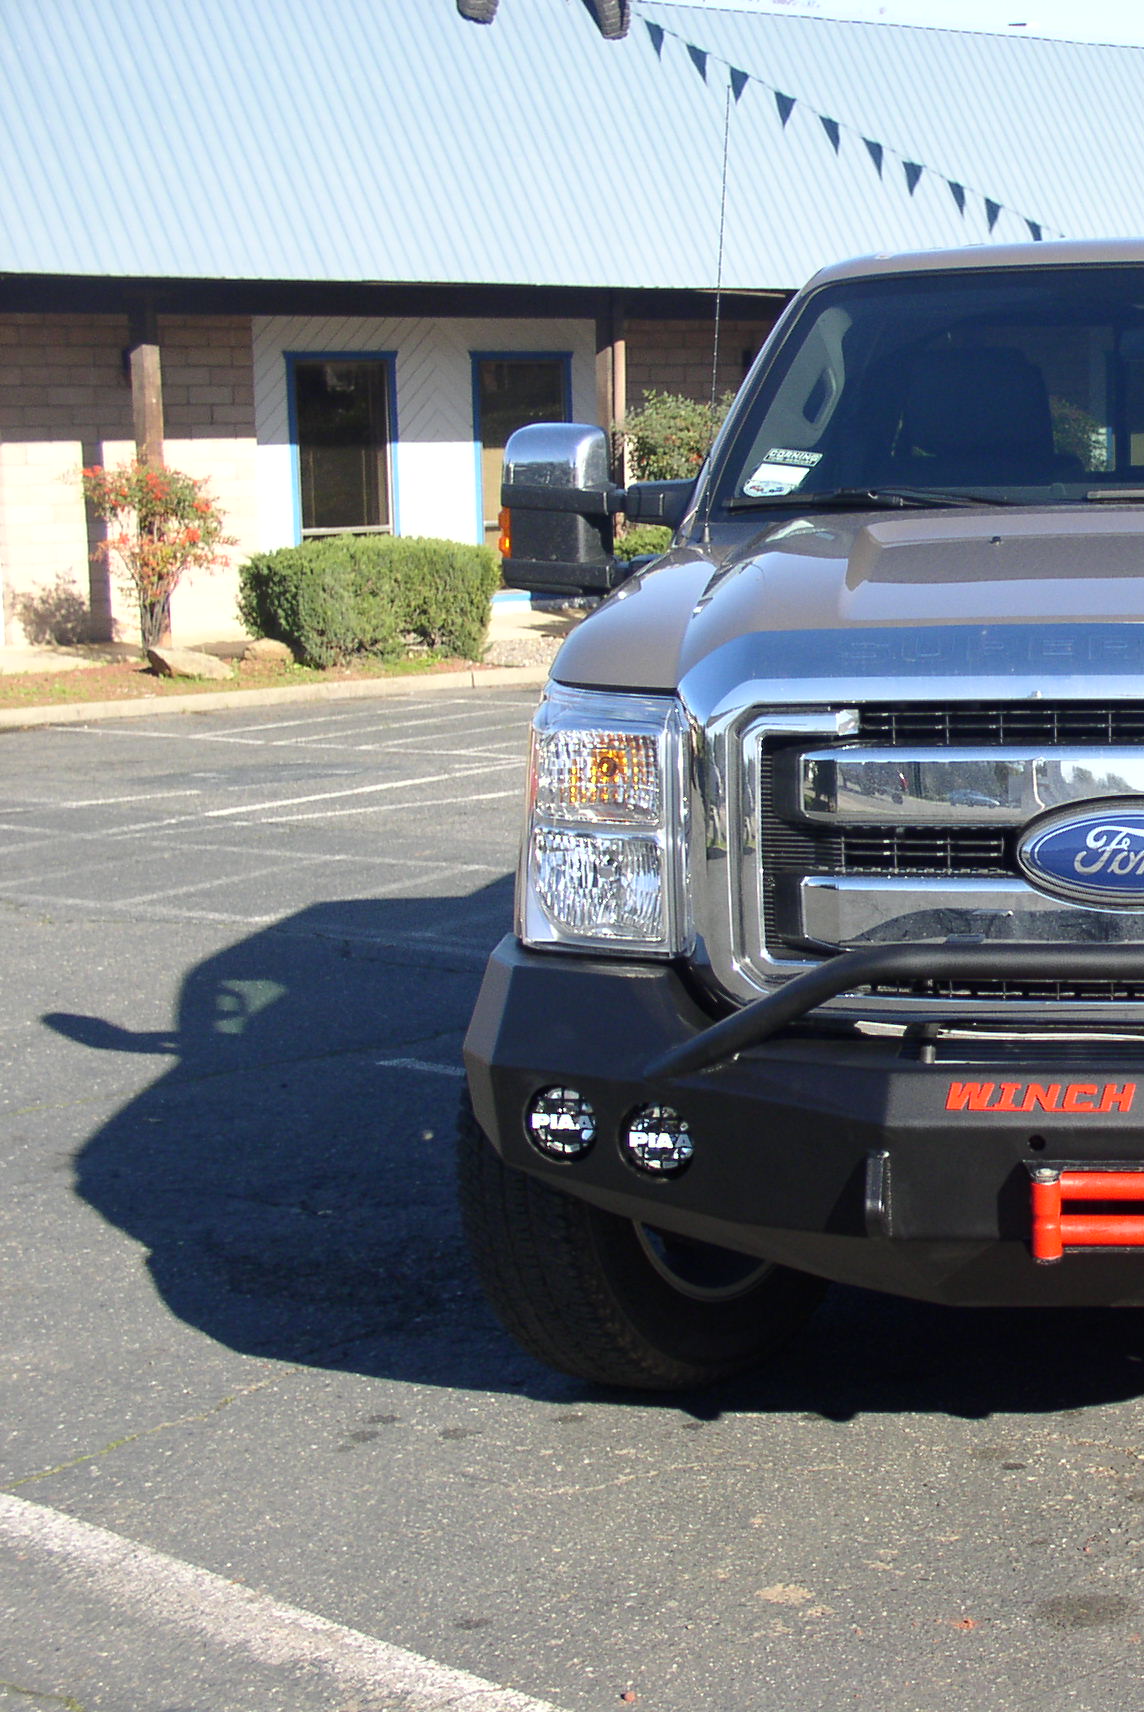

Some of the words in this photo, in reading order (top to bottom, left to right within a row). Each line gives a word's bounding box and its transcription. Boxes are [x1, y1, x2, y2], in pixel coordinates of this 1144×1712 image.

[839, 634, 1143, 662] SUPER
[945, 1082, 1136, 1113] WINCH
[531, 1113, 594, 1131] PIAA
[628, 1131, 693, 1149] PIAA
